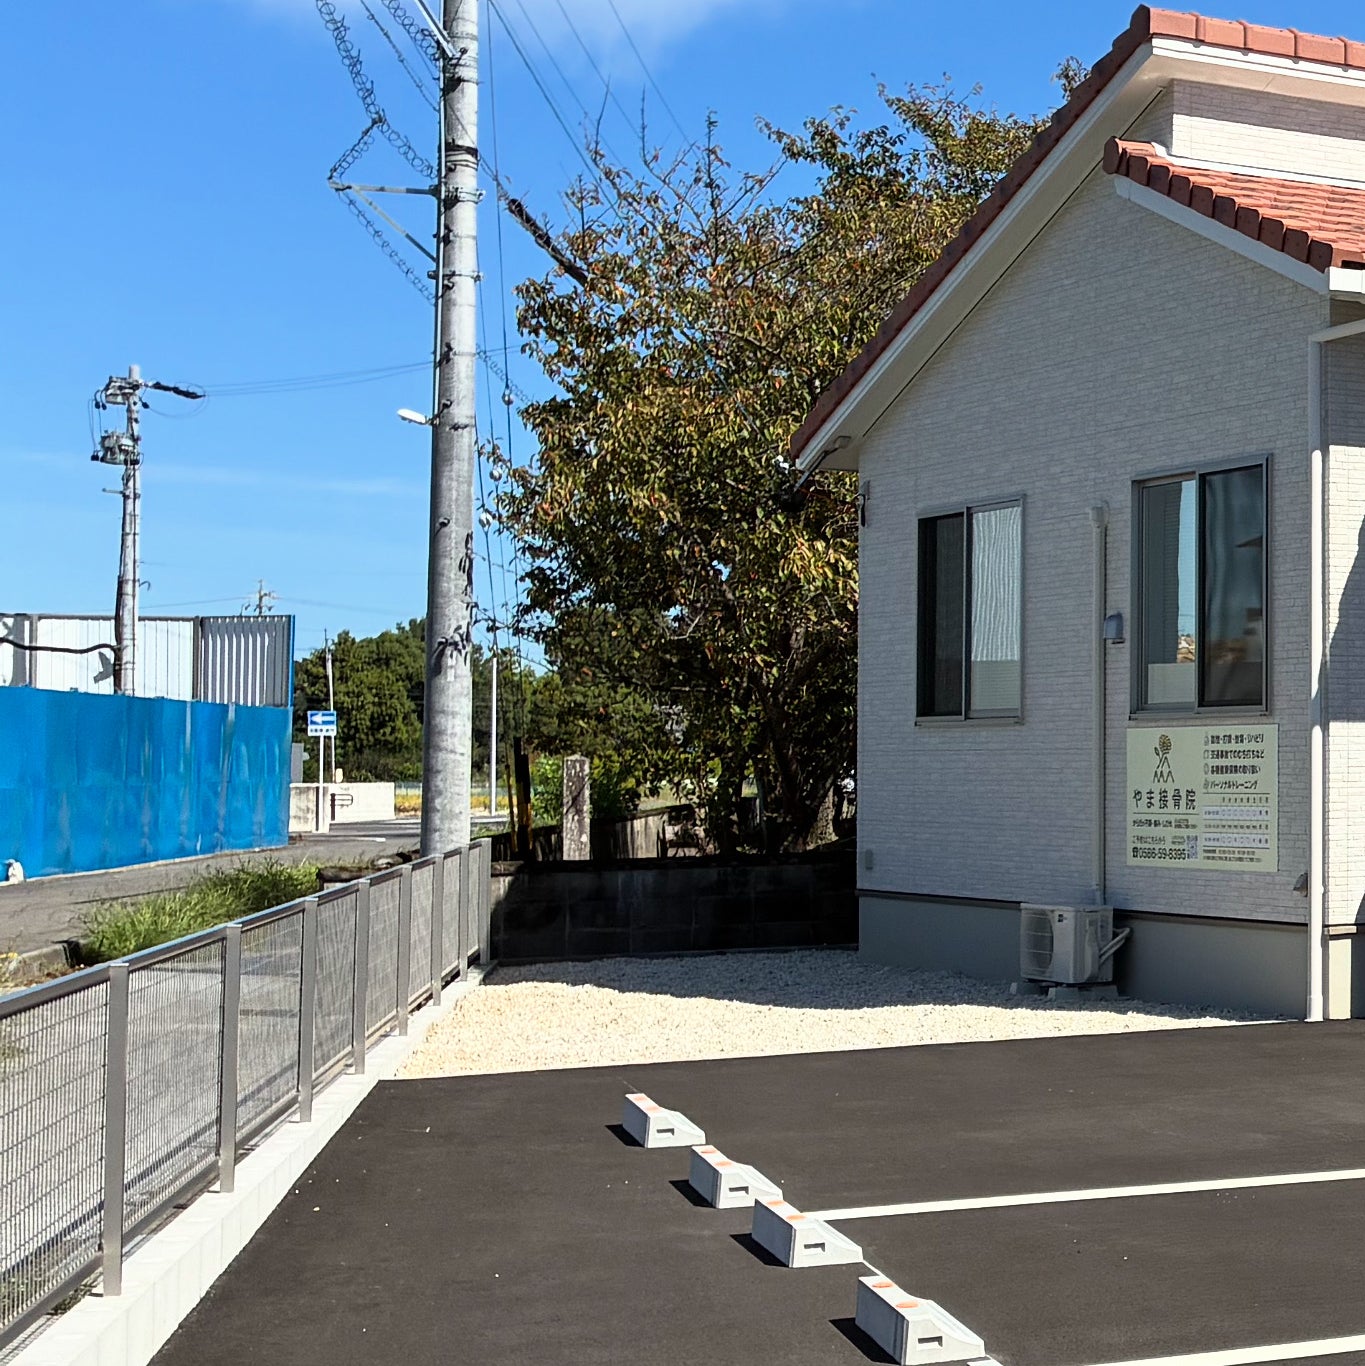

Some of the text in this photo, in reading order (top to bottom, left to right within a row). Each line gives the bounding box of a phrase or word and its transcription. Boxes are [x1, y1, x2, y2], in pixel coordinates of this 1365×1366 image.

[1132, 788, 1197, 810] やま接骨院
